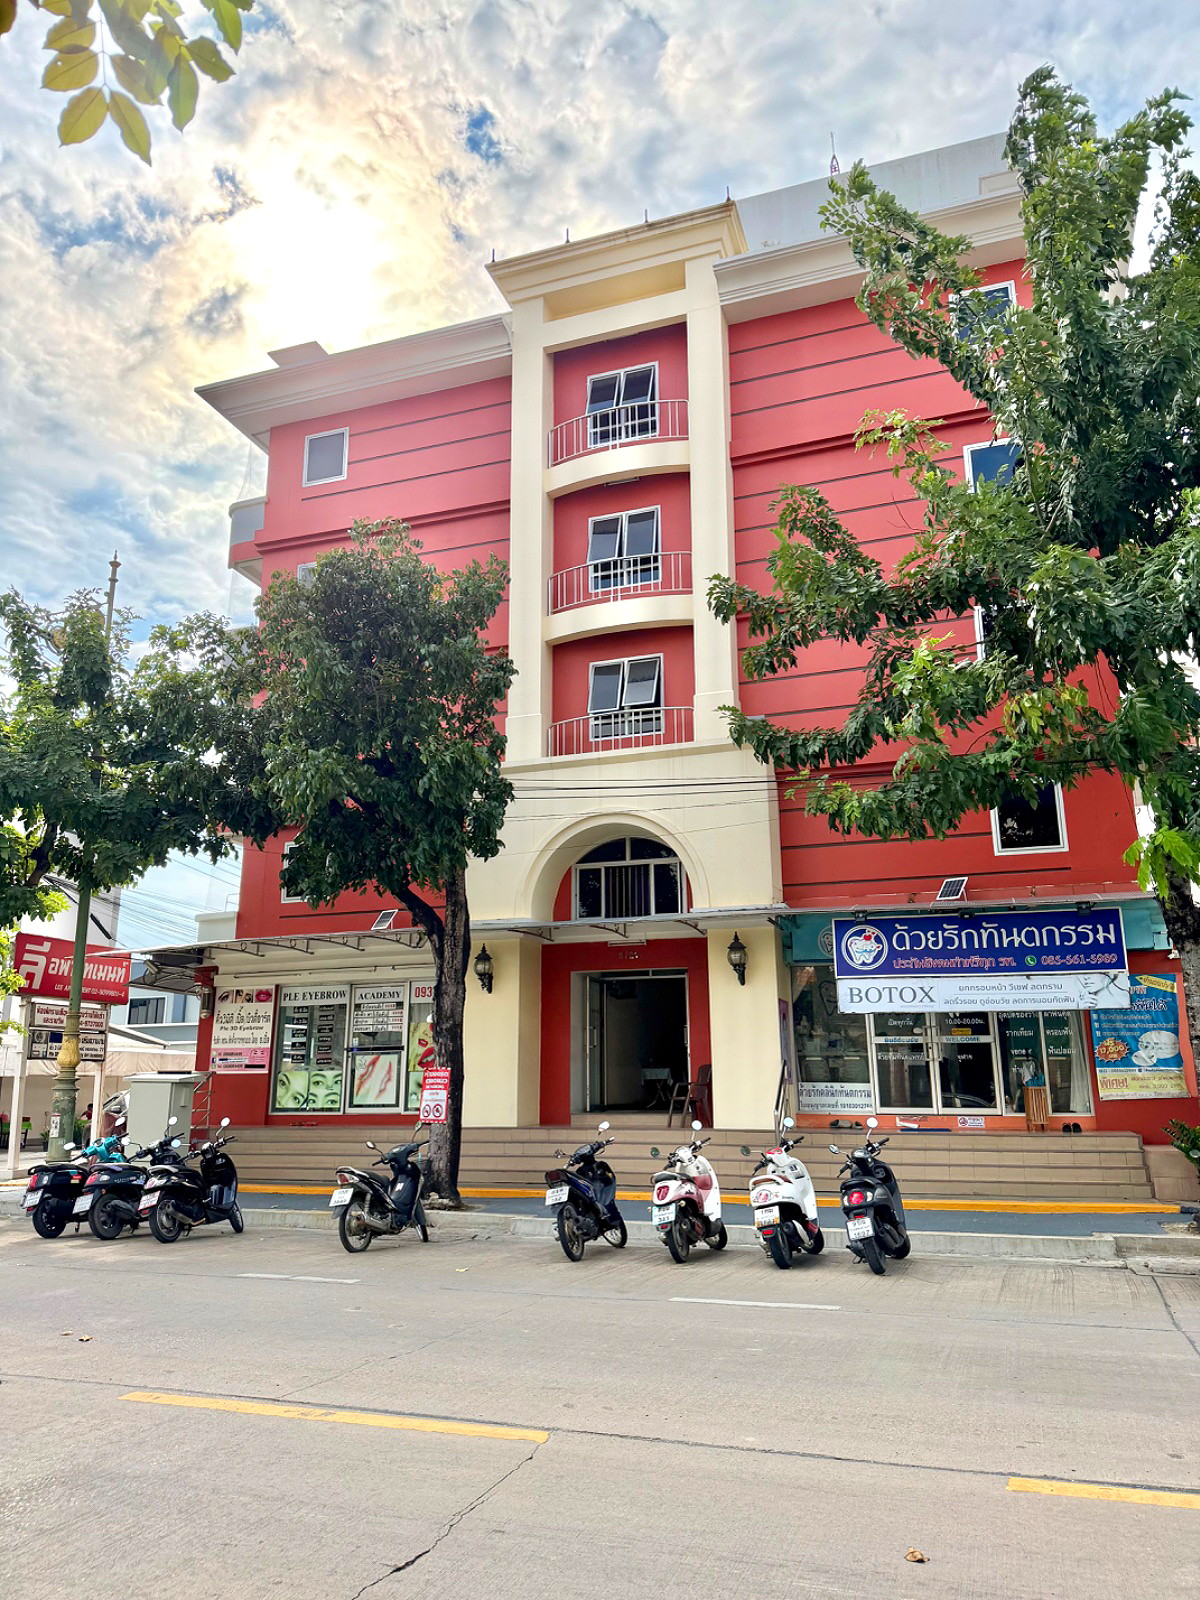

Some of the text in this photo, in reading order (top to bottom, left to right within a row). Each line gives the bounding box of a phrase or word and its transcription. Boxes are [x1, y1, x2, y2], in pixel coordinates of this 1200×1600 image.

[892, 921, 1116, 951] ด้วยรักทันตกรรม
[958, 983, 1007, 993] ยกกรอบหน้า
[1030, 983, 1063, 991] ลดกราม
[283, 990, 347, 1001] PLE EYEBROW
[358, 990, 401, 1000] ACADEMY
[848, 986, 936, 1005] BOTOX
[1006, 1027, 1034, 1036] รากเทียม
